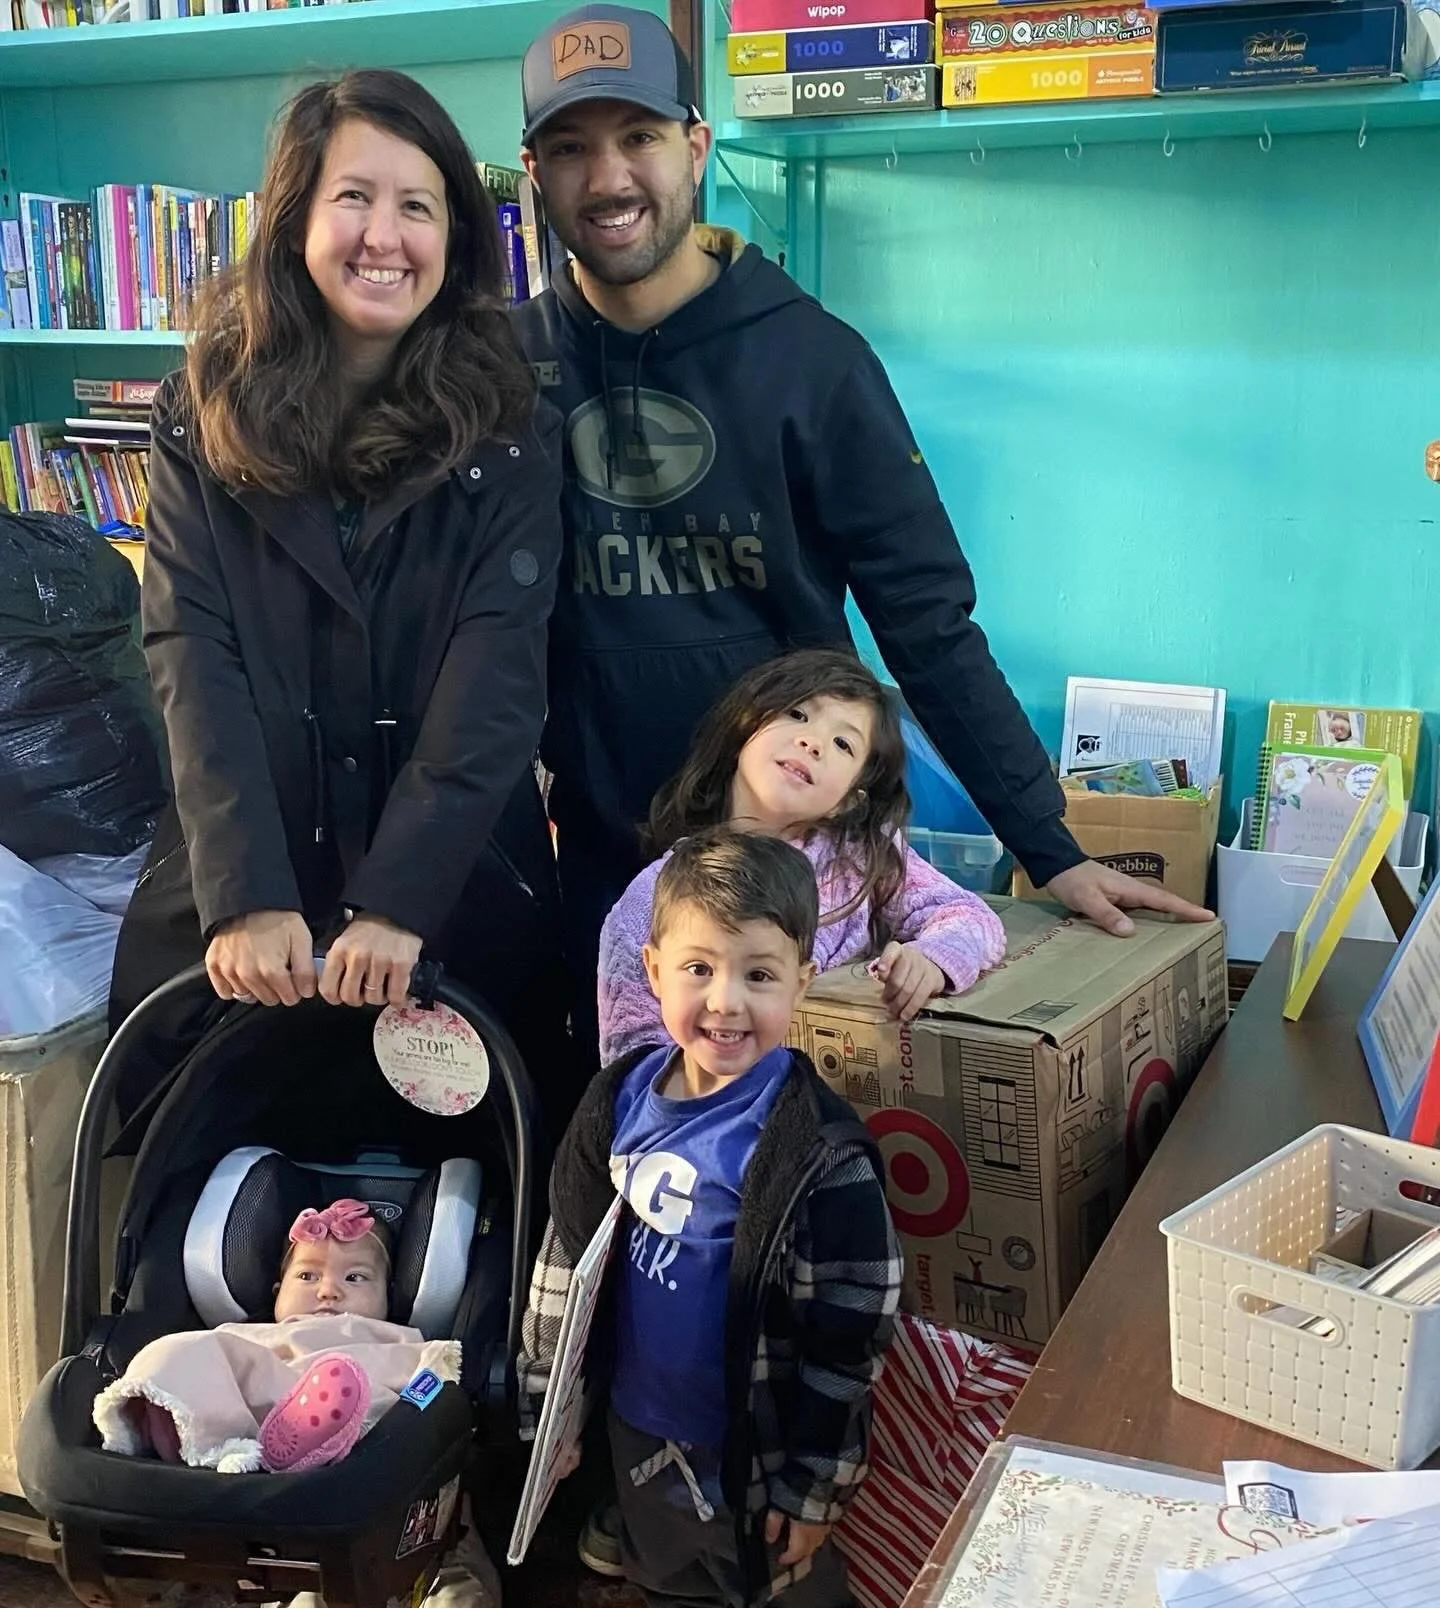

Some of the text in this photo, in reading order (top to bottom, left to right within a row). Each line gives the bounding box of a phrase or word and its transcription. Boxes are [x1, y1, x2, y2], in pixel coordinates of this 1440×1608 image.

[969, 19, 1007, 46] 20
[1118, 31, 1132, 41] for
[559, 34, 624, 63] DAD
[794, 40, 844, 57] 1000
[1031, 69, 1083, 88] 1000
[796, 81, 845, 99] 1000
[569, 397, 704, 498] G
[684, 512, 761, 533] BAY
[1104, 858, 1158, 872] Debbie
[407, 1036, 455, 1058] STOP!
[1088, 1504, 1104, 1524] NEW
[1129, 1513, 1155, 1564] CHRISTMAS
[1100, 1532, 1131, 1601] CHRISTMAS DAY
